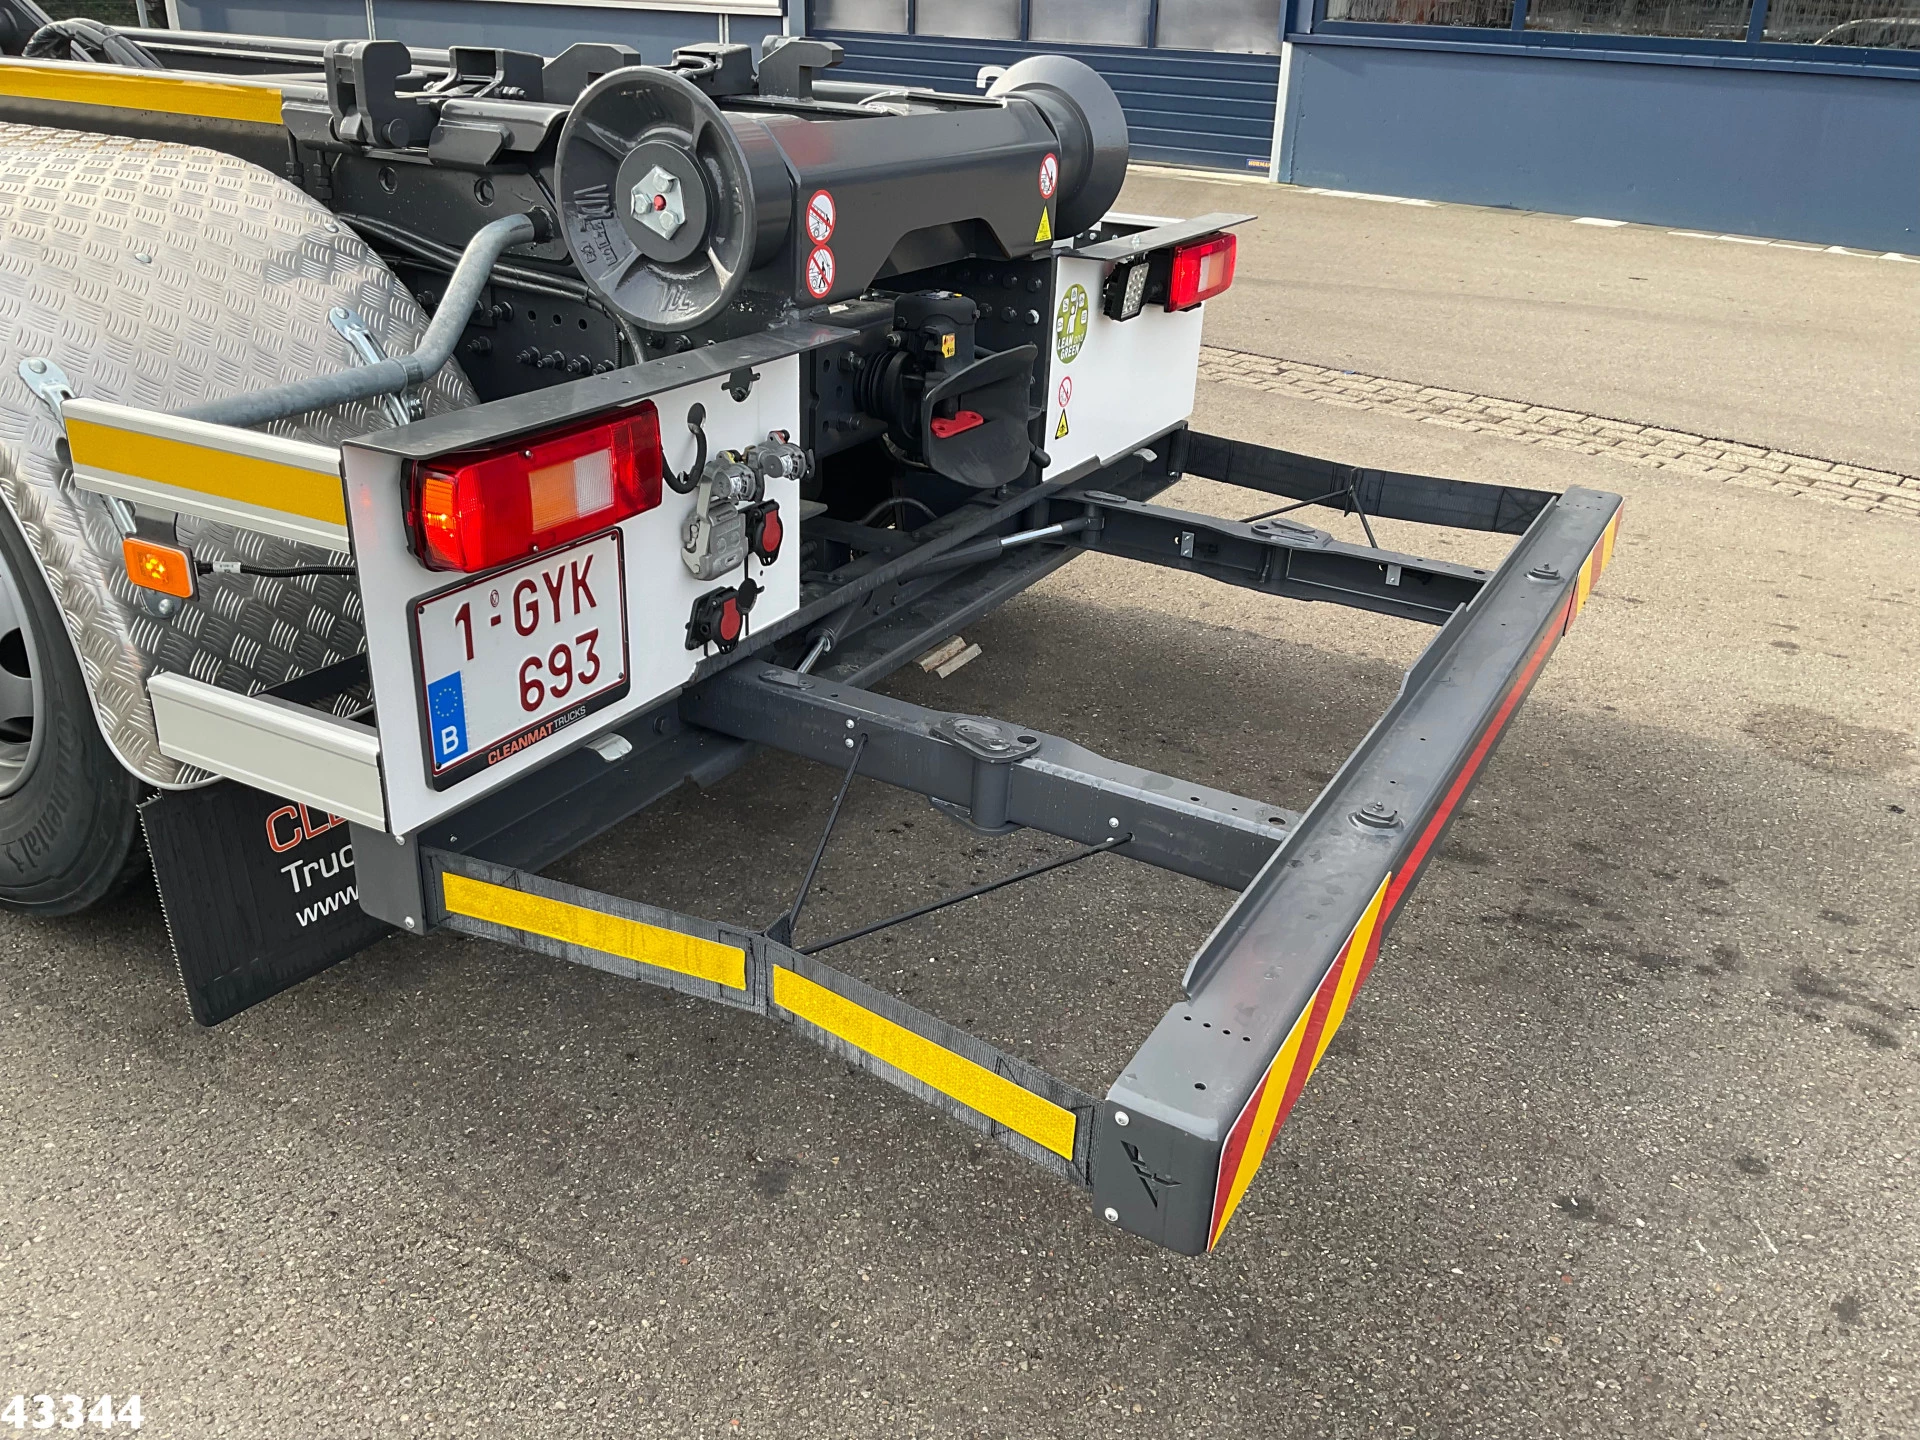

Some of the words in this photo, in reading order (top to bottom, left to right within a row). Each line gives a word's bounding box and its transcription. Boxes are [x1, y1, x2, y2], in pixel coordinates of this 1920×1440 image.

[1057, 334, 1074, 350] LEAN
[1060, 343, 1080, 360] GREEN
[519, 628, 600, 712] 693
[441, 725, 459, 755] B
